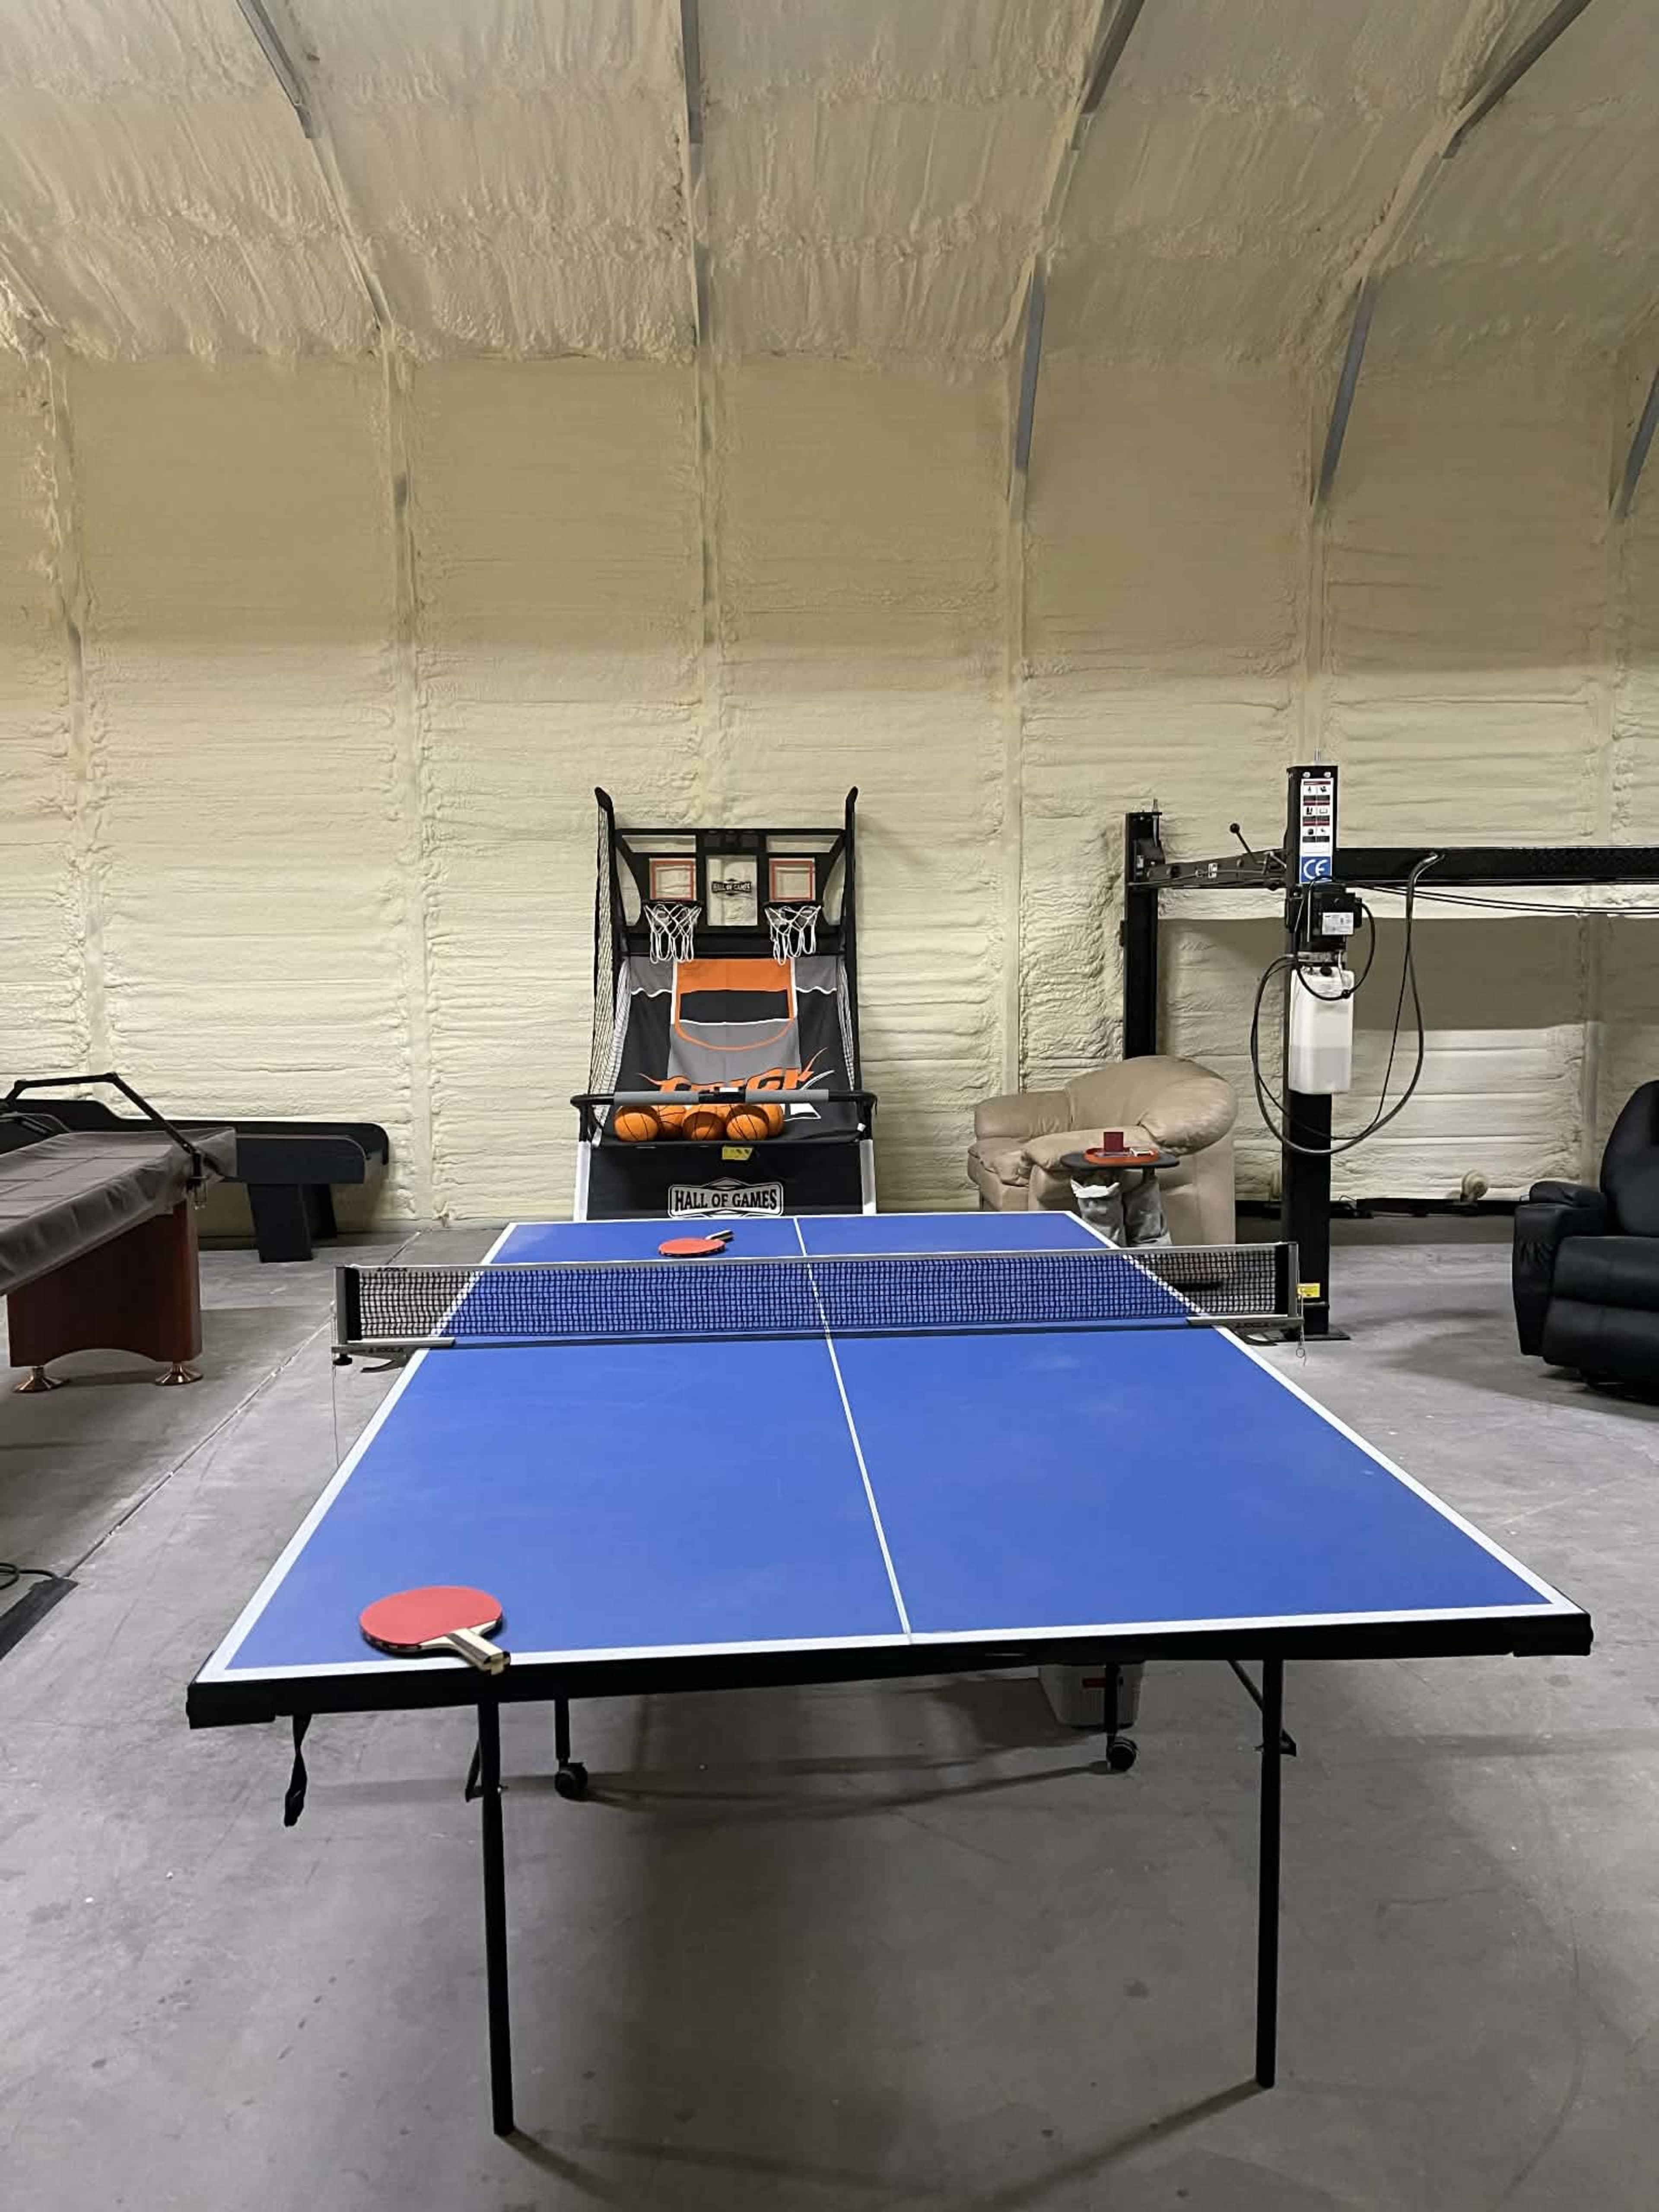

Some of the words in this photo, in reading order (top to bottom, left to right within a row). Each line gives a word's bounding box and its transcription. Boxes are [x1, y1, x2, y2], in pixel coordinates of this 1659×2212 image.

[675, 1190, 708, 1211] HALL
[712, 1193, 728, 1207] OF
[732, 1189, 777, 1210] GAMES
